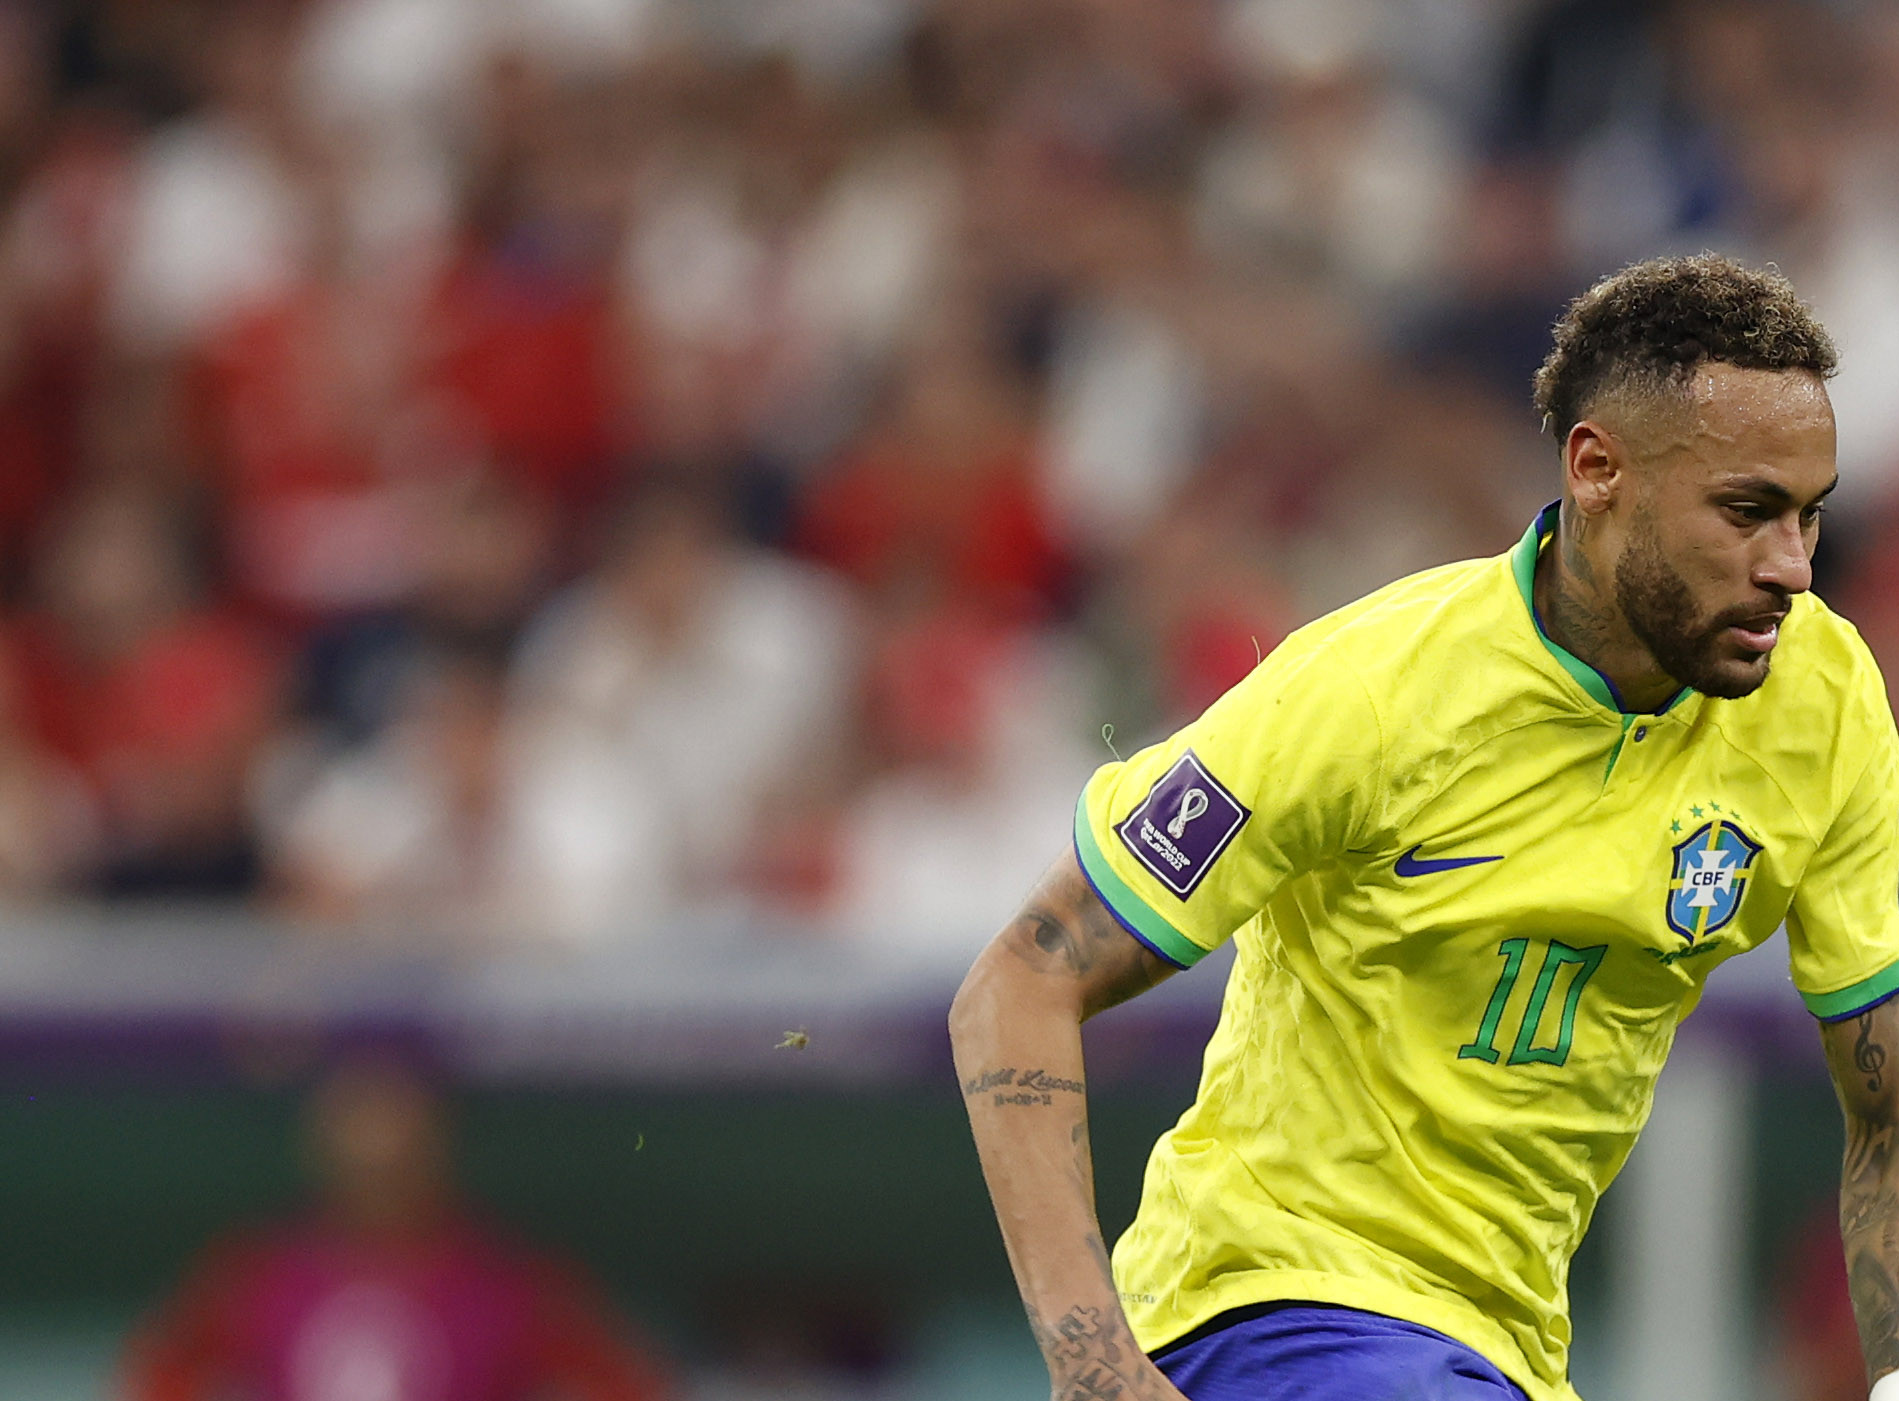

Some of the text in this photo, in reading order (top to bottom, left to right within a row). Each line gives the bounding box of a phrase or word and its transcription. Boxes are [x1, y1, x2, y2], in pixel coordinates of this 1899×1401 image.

[1153, 829, 1179, 856] WORLD
[1176, 851, 1191, 867] CUP
[1692, 871, 1725, 887] CBF
[1457, 937, 1609, 1068] 10
